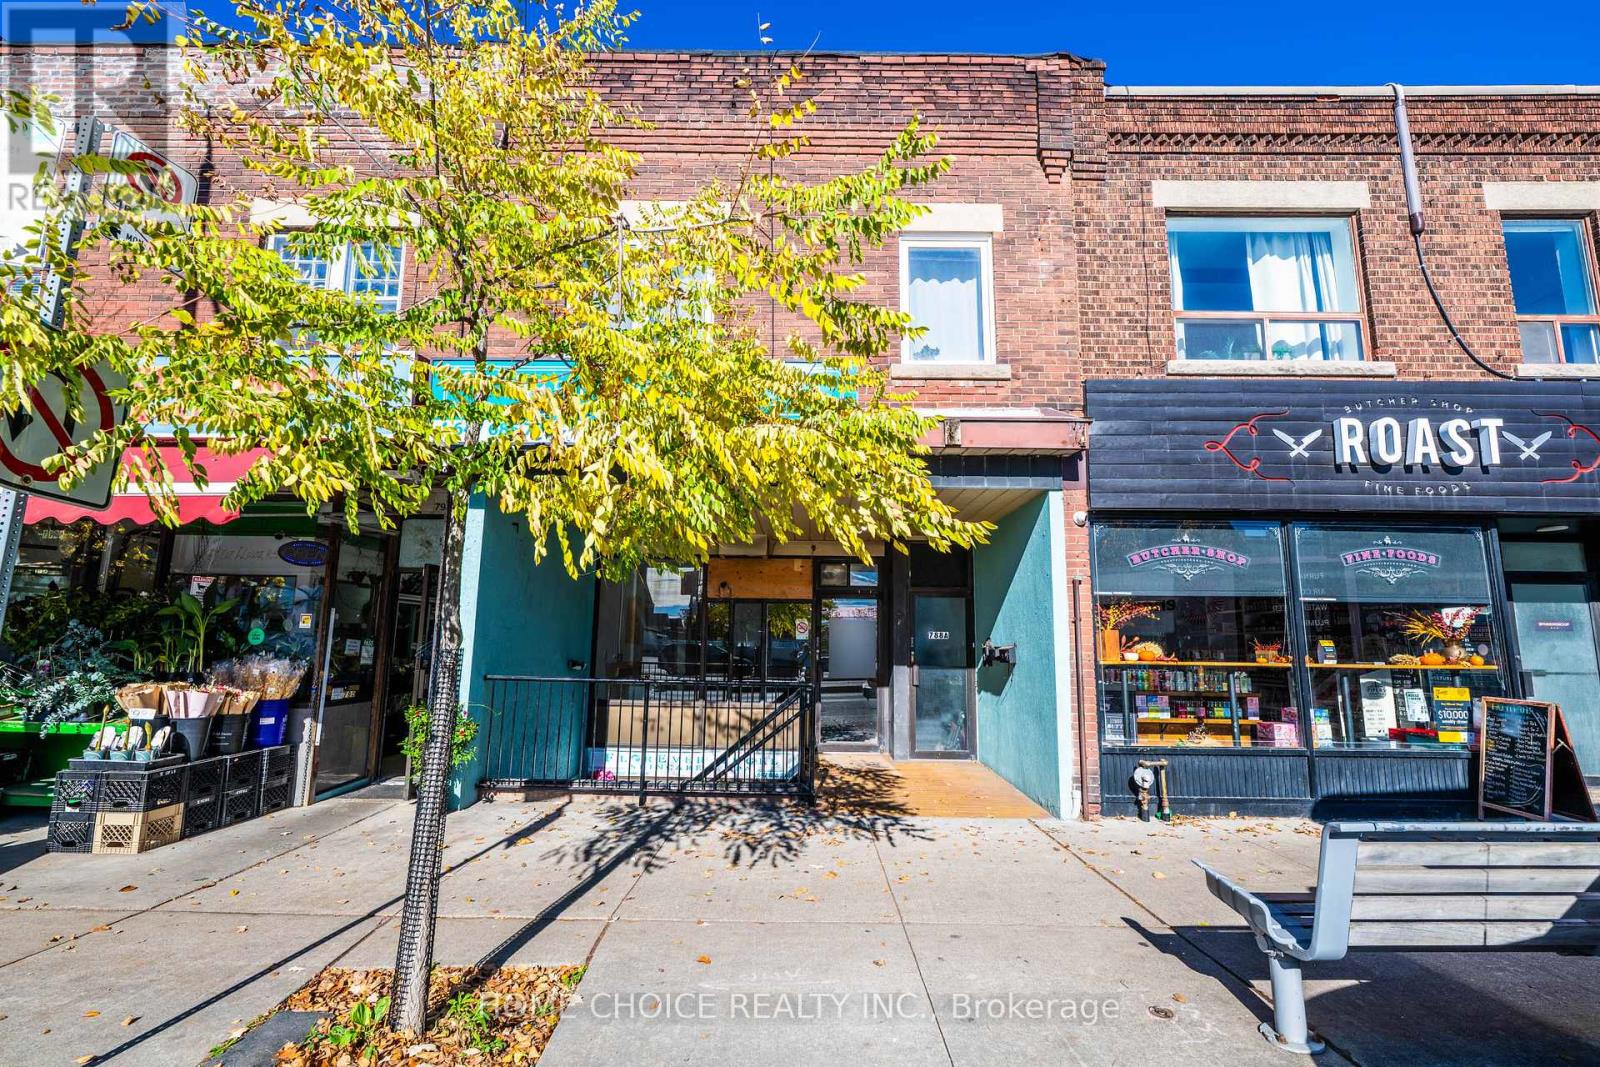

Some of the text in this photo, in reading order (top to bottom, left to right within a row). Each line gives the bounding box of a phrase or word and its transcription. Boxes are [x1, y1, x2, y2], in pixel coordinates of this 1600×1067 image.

[1344, 397, 1475, 414] BUTCHER SHOP
[1333, 417, 1504, 466] ROAST
[1364, 480, 1471, 495] FINE FOODS
[1130, 546, 1200, 565] BUTCHER
[1206, 547, 1247, 566] SHOP
[1345, 549, 1437, 564] FINE FOODS
[1438, 710, 1469, 720] $10,000
